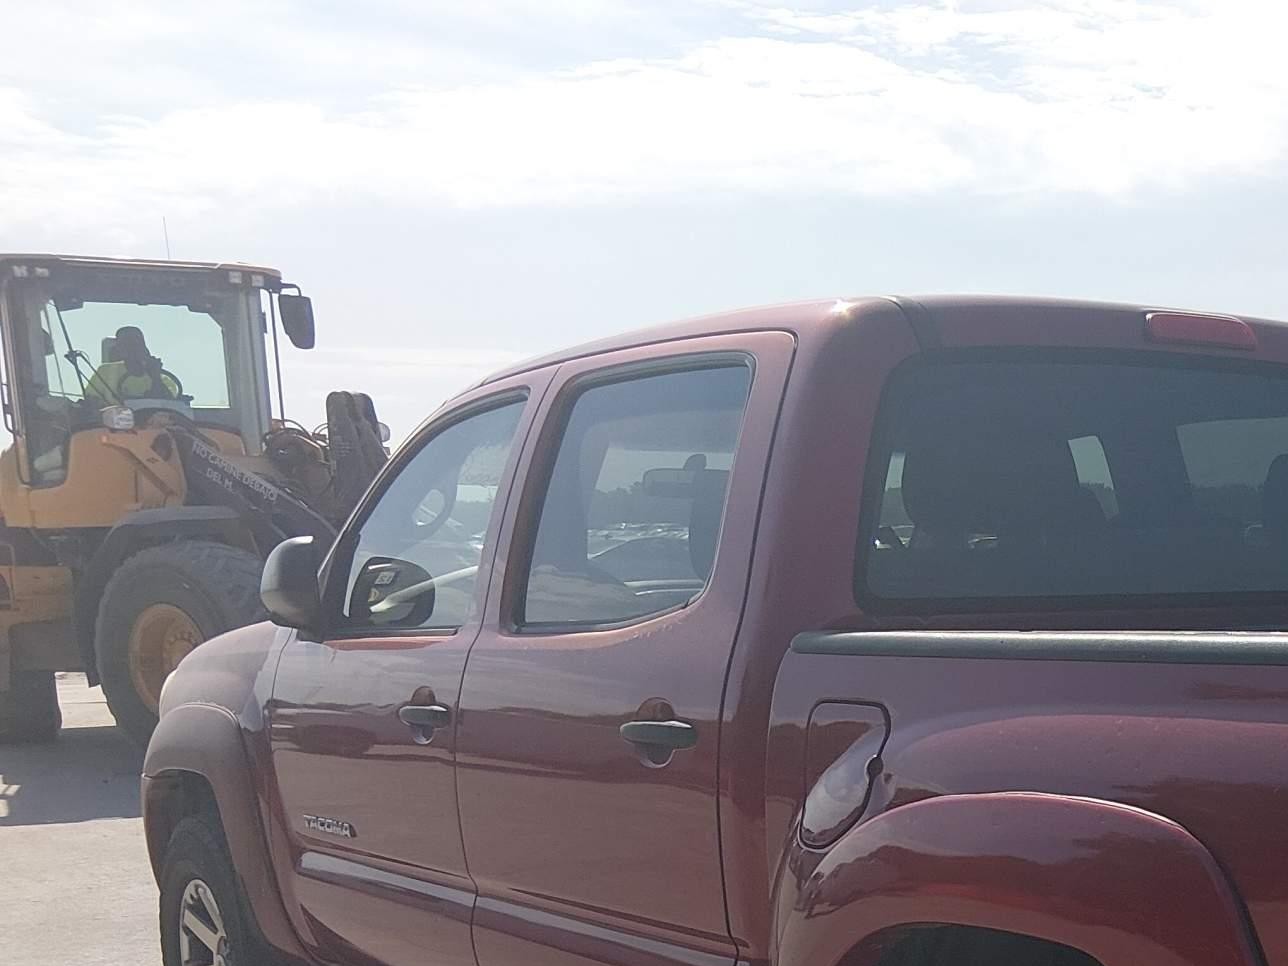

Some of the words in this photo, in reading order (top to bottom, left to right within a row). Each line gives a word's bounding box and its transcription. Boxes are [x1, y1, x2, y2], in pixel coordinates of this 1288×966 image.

[192, 439, 208, 458] NO
[206, 468, 222, 484] DEL
[303, 814, 351, 838] TACOMA
